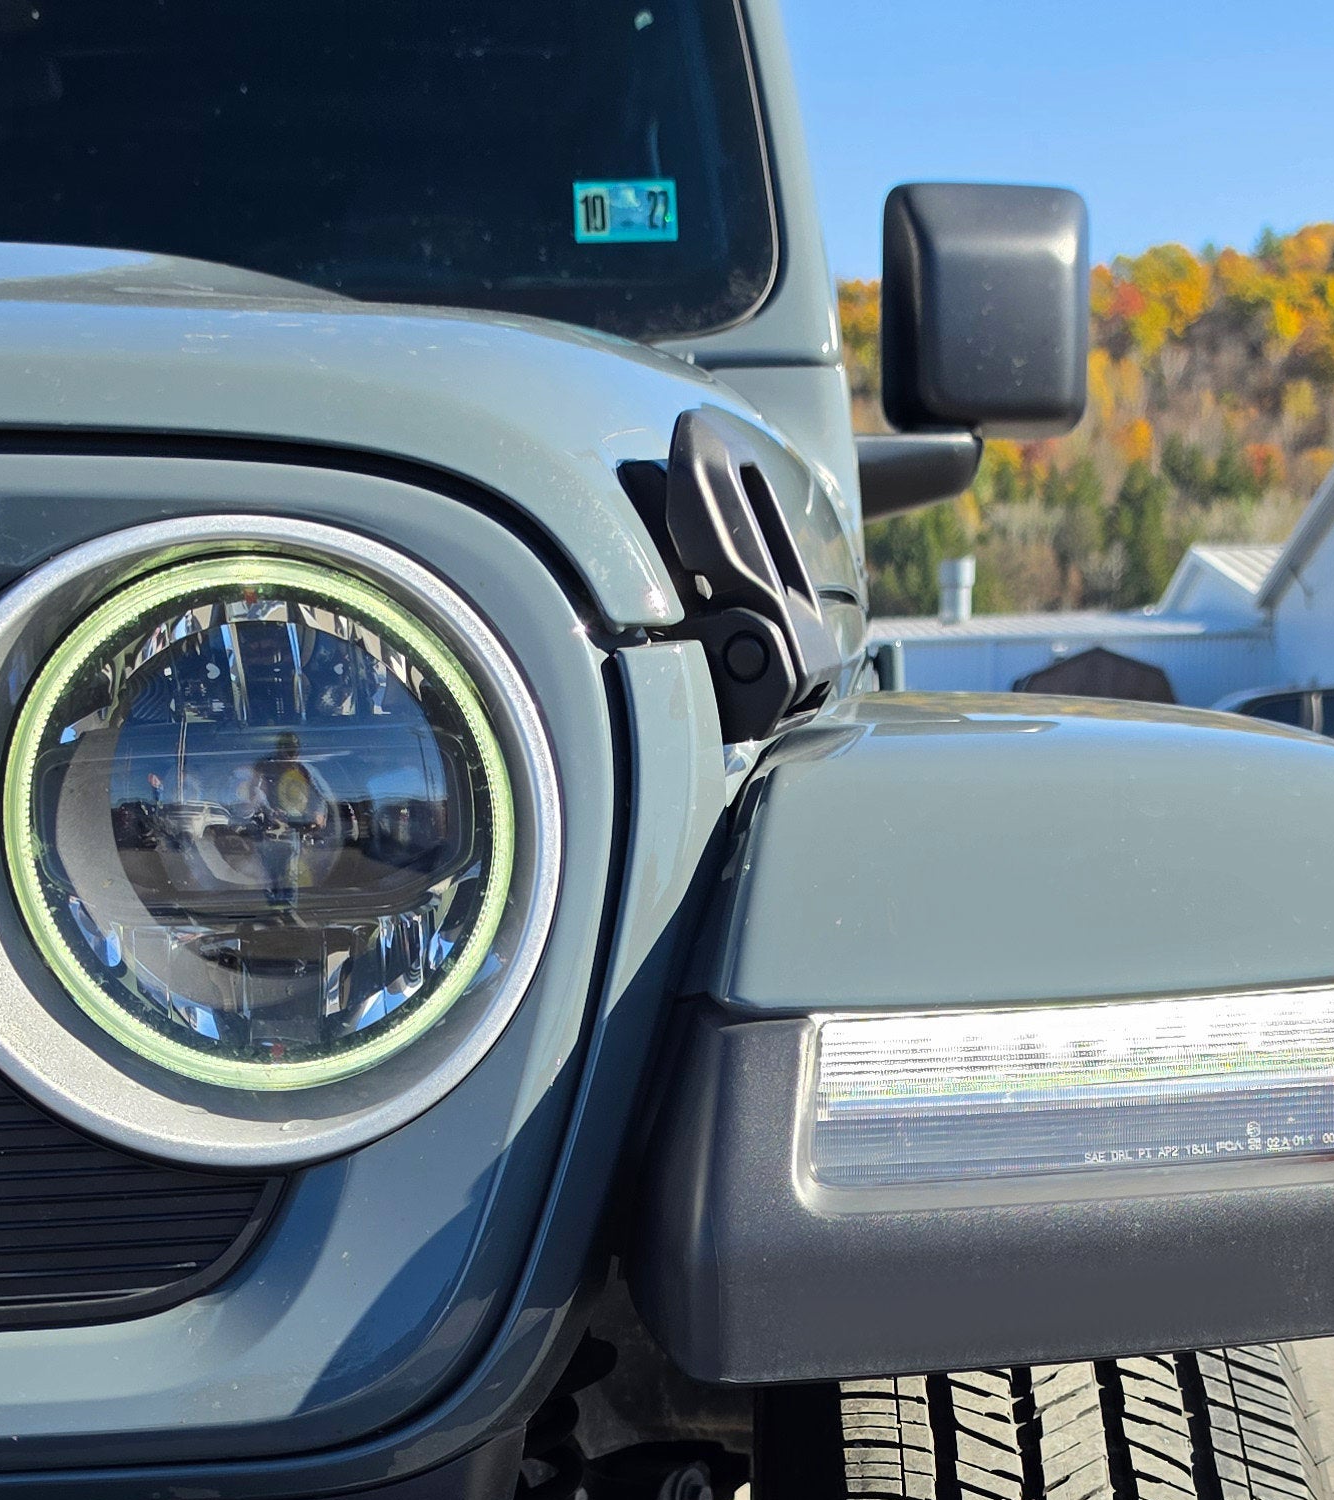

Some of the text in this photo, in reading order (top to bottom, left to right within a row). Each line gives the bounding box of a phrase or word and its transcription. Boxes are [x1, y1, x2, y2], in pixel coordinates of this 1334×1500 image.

[580, 194, 606, 233] 10
[1084, 1151, 1106, 1163] SAE
[1112, 1149, 1133, 1161] DRL
